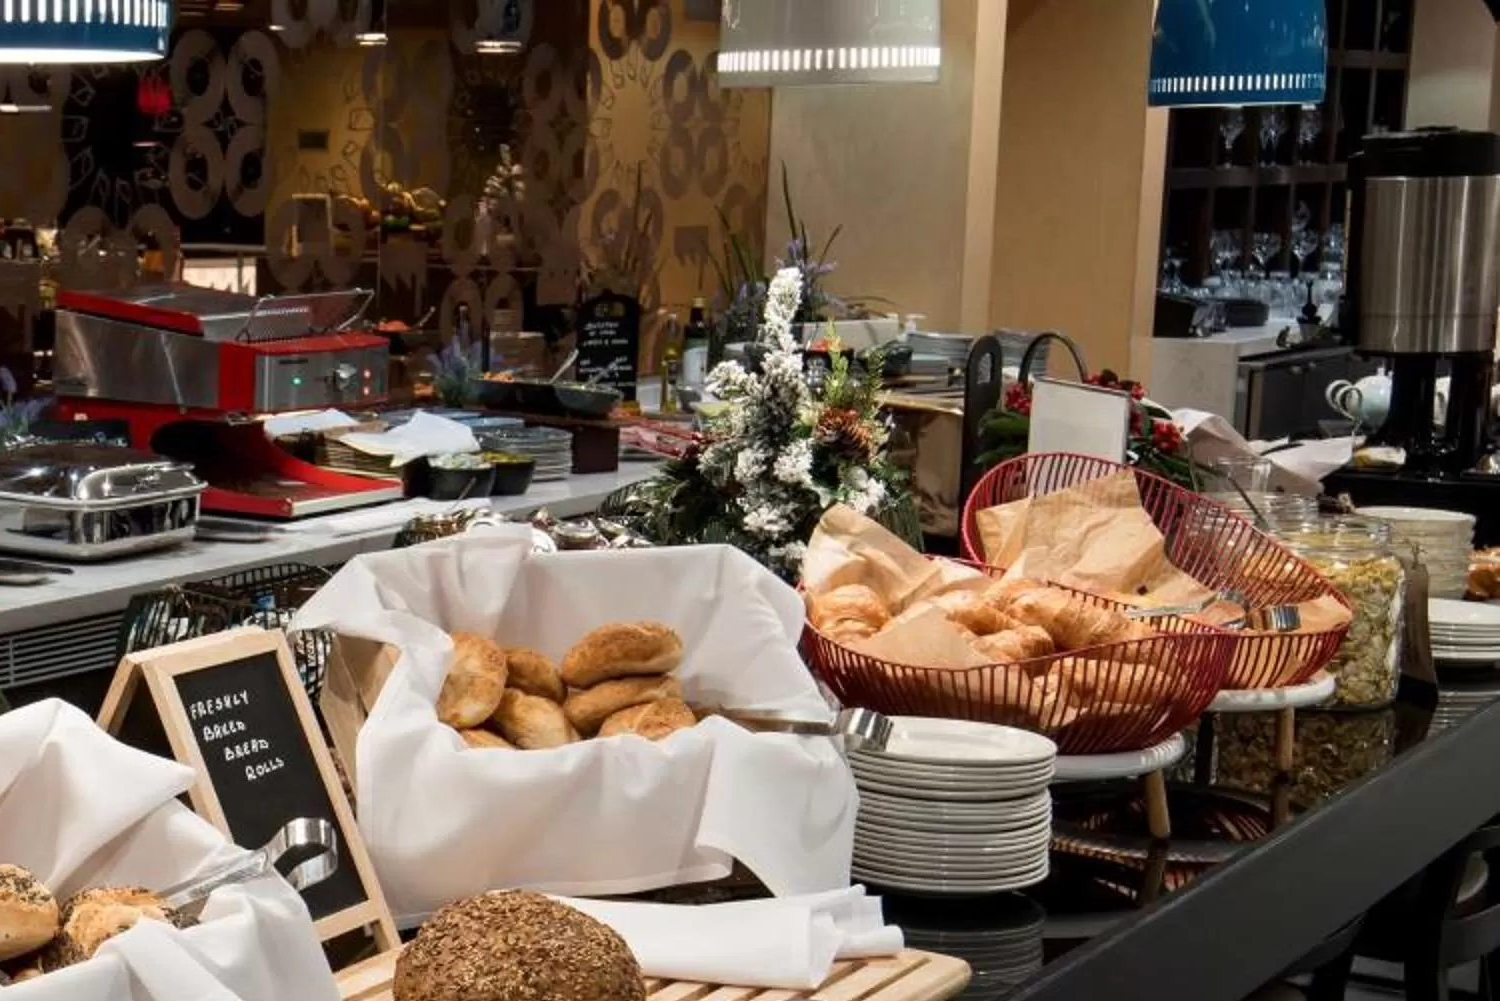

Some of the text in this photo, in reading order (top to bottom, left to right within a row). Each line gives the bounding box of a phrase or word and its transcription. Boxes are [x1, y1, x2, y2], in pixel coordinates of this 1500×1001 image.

[190, 690, 249, 720] FRESHLY
[225, 739, 269, 762] BREAD
[245, 757, 284, 780] ROLLS
